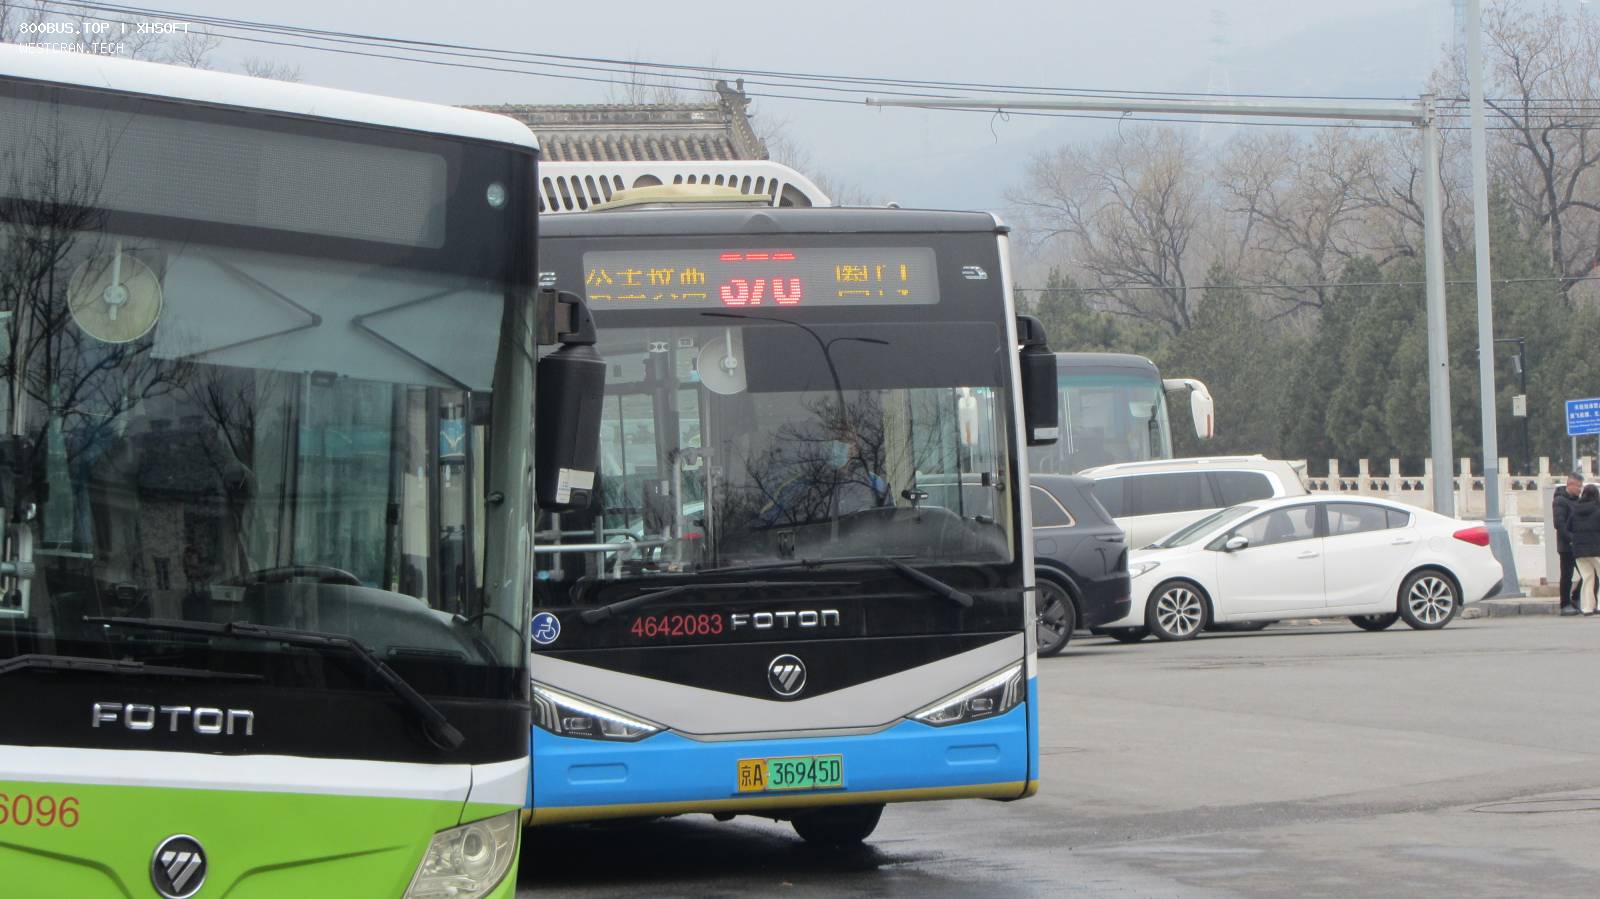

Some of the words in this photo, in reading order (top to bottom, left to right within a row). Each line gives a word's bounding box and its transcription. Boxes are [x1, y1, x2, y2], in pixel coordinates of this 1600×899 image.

[631, 613, 724, 637] 4642083
[730, 608, 840, 631] FOTON
[92, 702, 254, 736] FOTON
